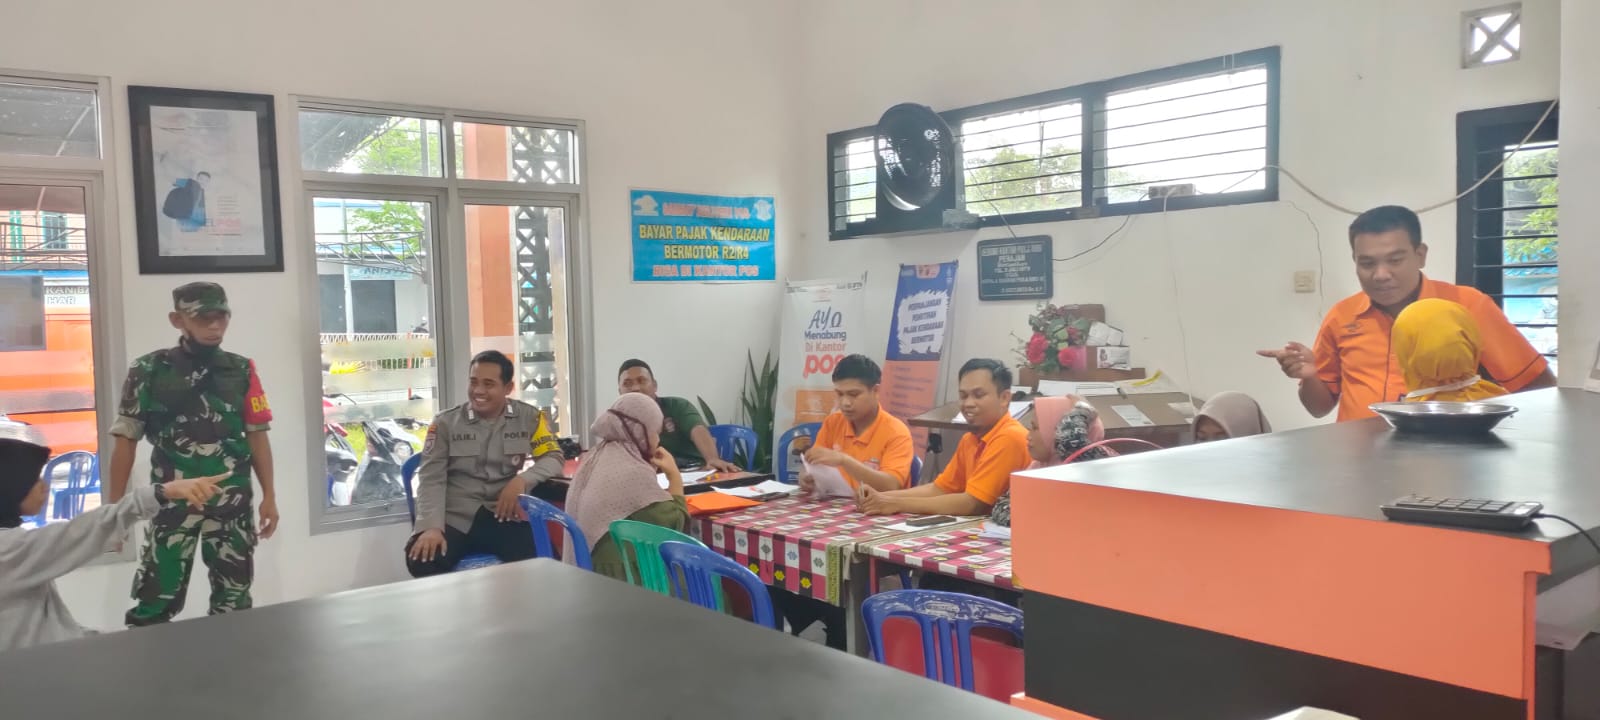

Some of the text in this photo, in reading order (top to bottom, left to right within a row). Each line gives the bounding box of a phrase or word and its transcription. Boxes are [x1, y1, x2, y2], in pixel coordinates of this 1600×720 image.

[639, 224, 770, 241] BAYAR PAJAK KENDARAAN
[664, 244, 719, 260] BERMOTOR
[804, 330, 847, 341] Menabung
[805, 342, 846, 352] Di Kantor
[503, 431, 529, 440] POLRI
